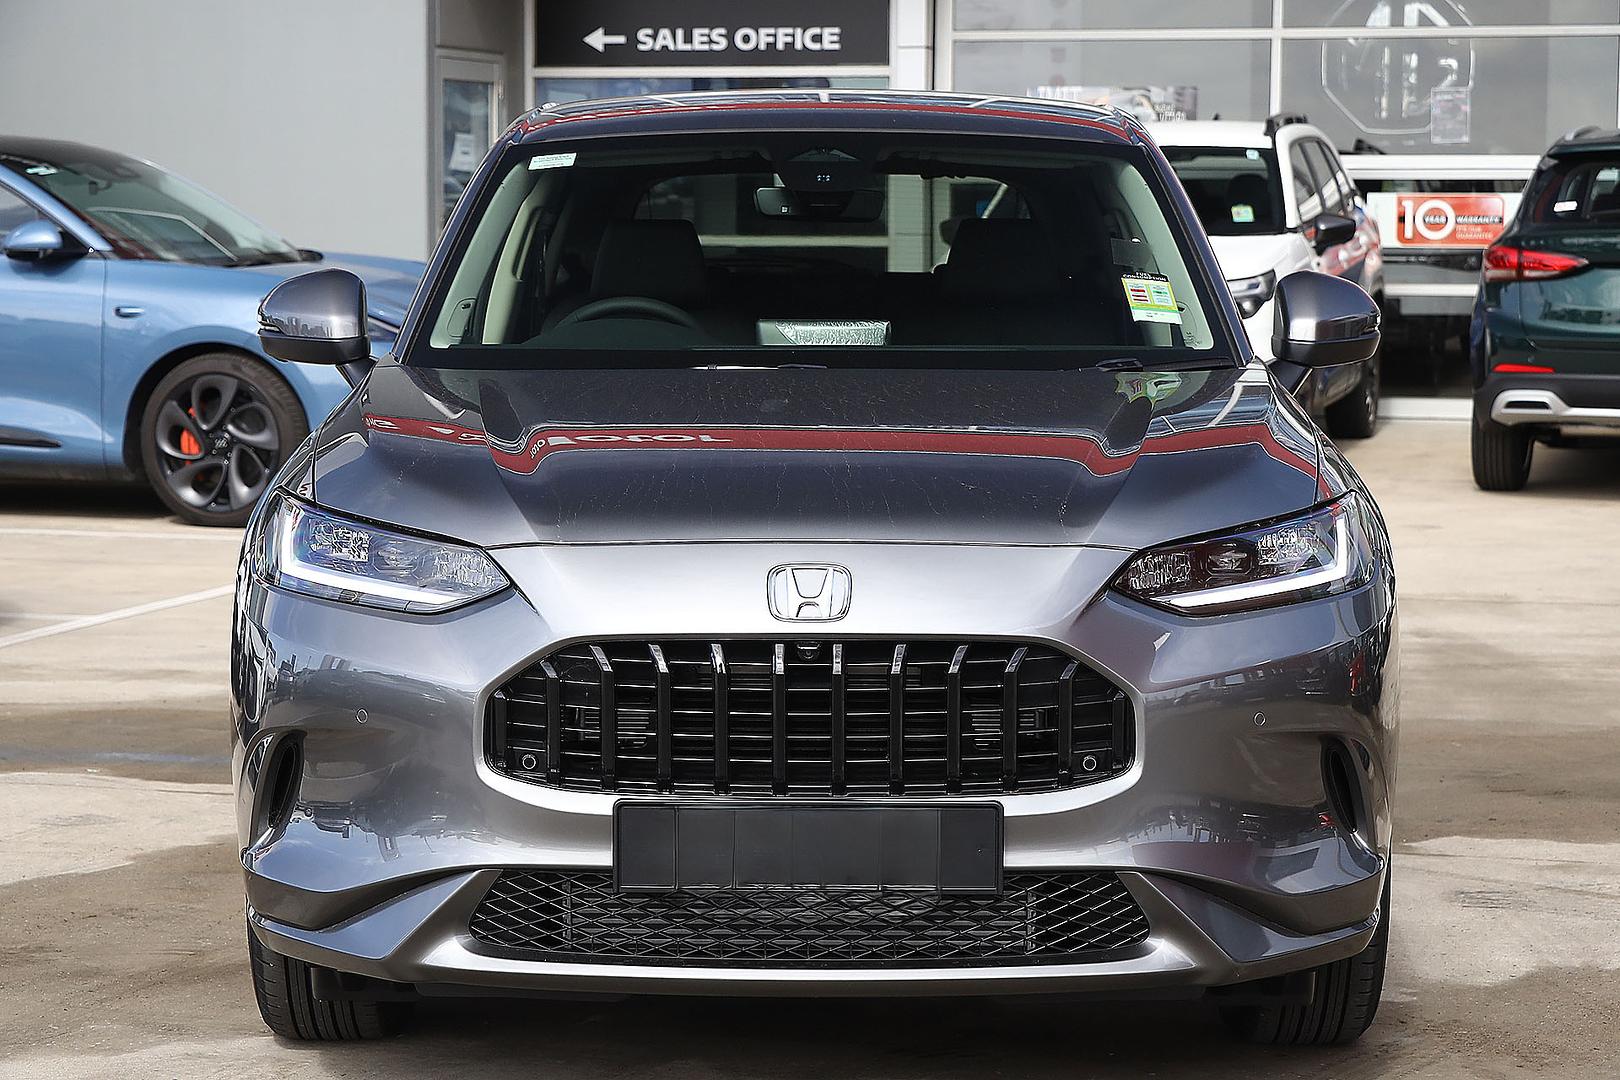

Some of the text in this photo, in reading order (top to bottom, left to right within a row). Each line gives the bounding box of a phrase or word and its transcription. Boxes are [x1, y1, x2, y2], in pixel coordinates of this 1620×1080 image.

[636, 27, 842, 51] SALES OFFICE
[1401, 199, 1456, 240] 10
